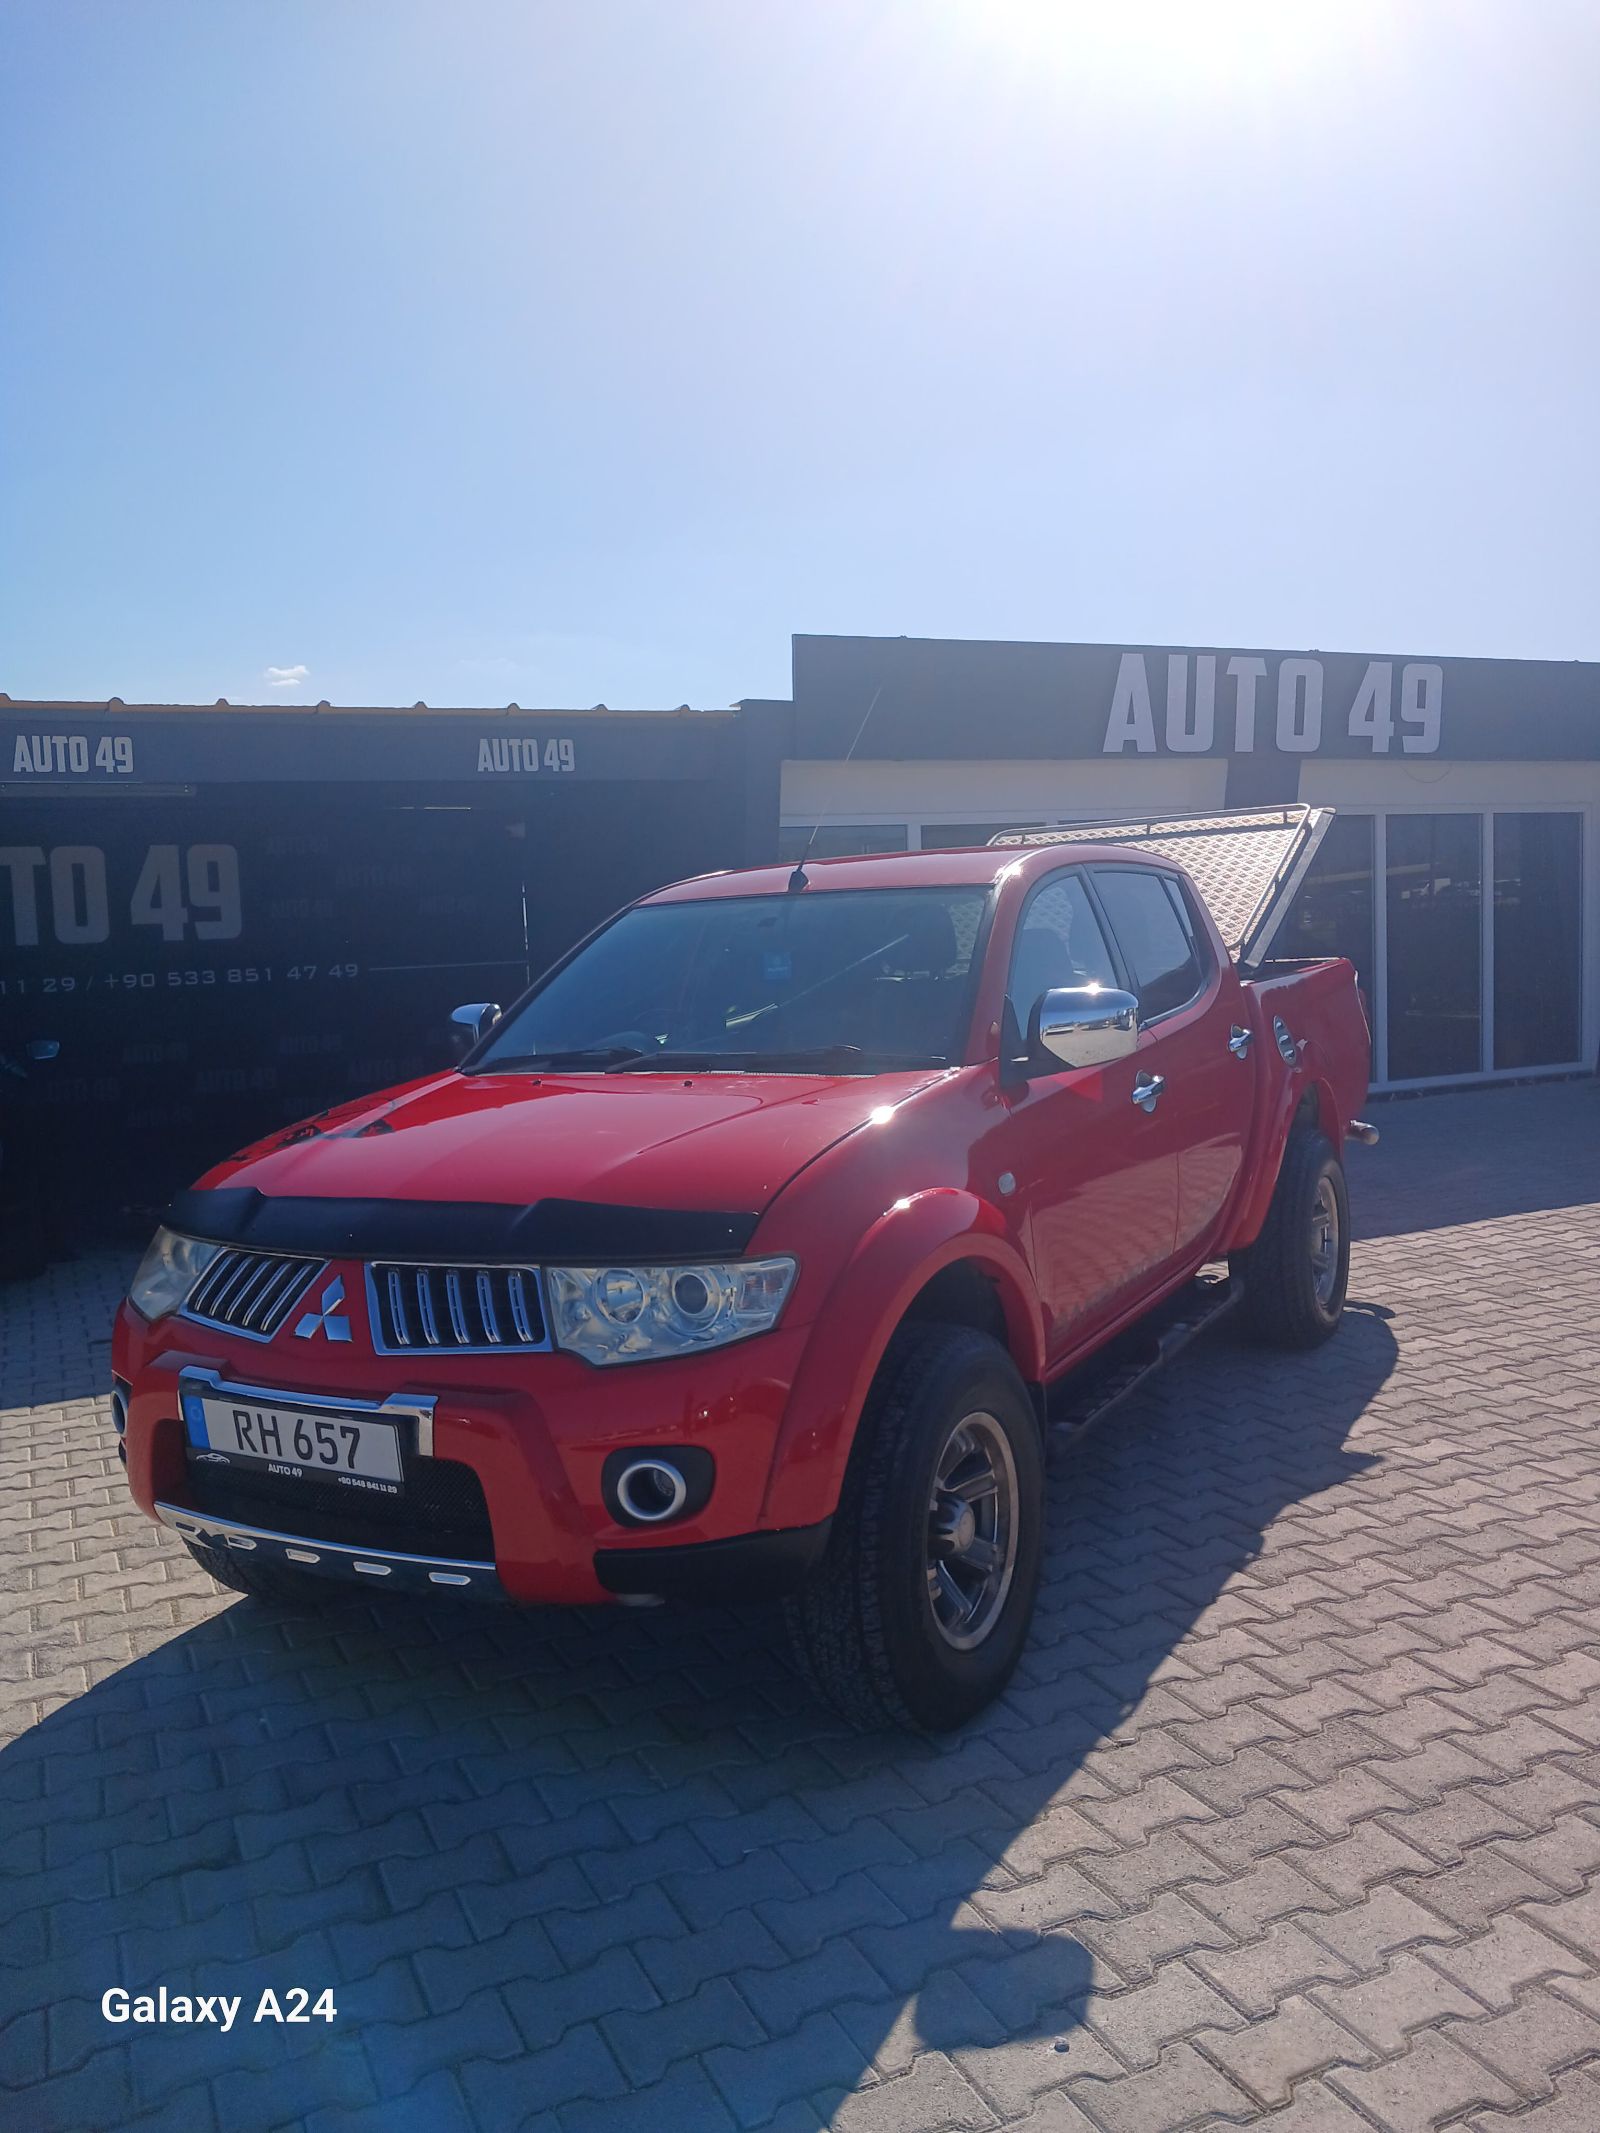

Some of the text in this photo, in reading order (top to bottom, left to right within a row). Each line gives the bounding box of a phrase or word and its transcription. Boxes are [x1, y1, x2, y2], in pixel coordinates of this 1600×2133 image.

[1102, 652, 1444, 754] AUTO 49
[13, 735, 134, 774] AUTO 49
[477, 738, 575, 772] AUTO 49
[130, 844, 242, 941] 49
[42, 976, 76, 993] 29
[104, 972, 156, 989] +90
[167, 970, 217, 986] 533
[227, 967, 273, 983] 851
[287, 965, 318, 980] 47
[329, 964, 359, 979] 49
[232, 1409, 361, 1470] RH 657
[268, 1463, 303, 1478] AUTO 49
